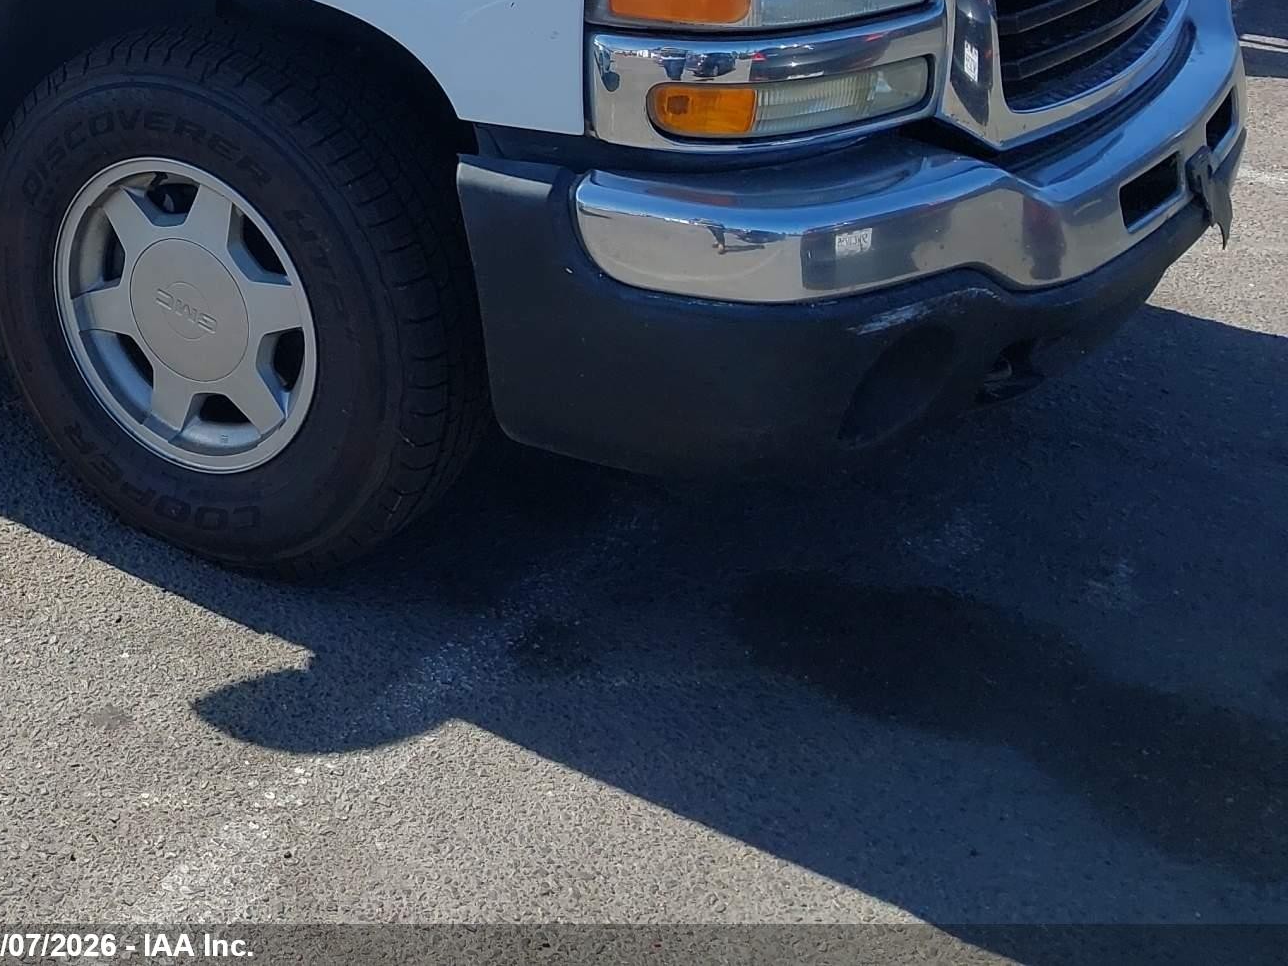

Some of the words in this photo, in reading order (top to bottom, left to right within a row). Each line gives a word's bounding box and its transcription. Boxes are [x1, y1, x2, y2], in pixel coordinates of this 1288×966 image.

[21, 107, 273, 202] DISCOVERER
[156, 288, 218, 334] GMC
[63, 419, 262, 531] COOPER
